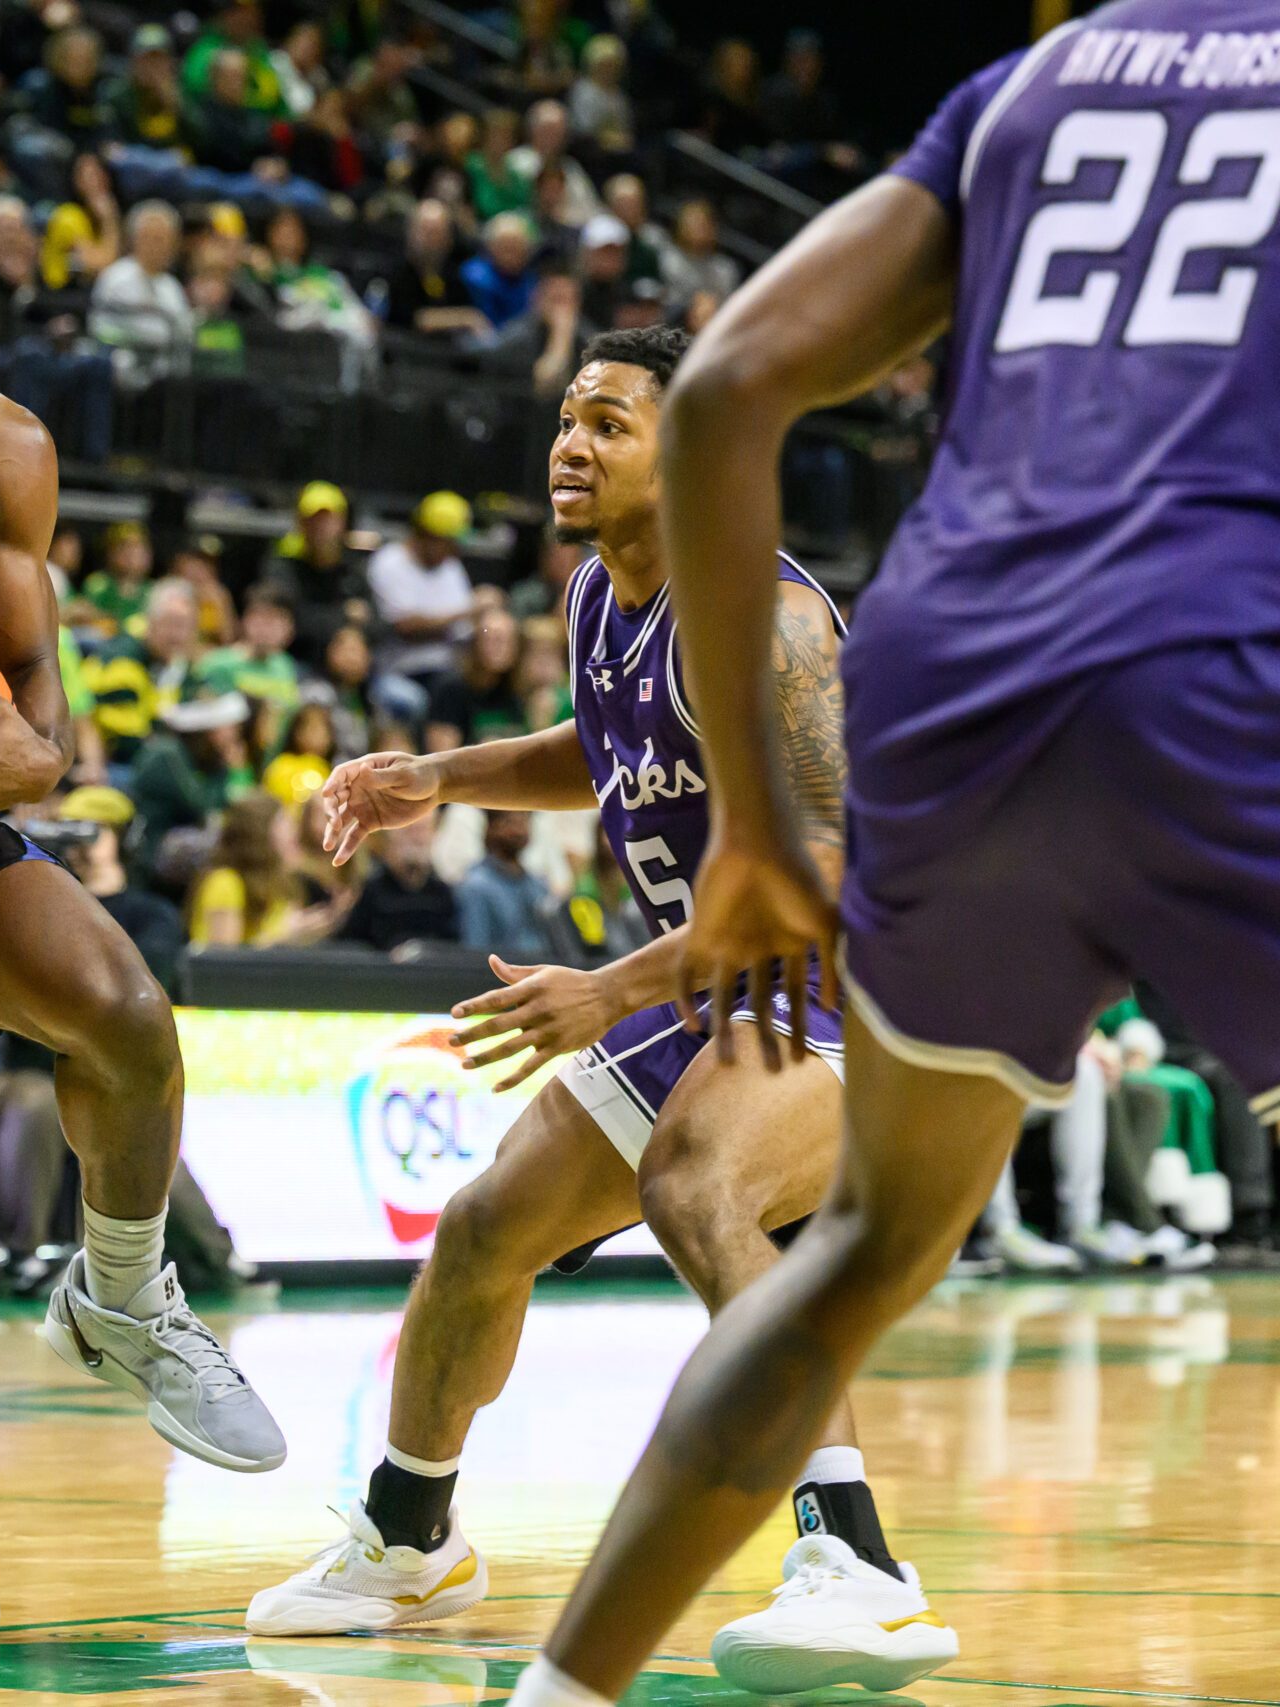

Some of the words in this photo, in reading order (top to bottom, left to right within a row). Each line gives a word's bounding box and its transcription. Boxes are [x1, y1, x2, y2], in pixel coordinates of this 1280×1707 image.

[993, 108, 1280, 353] 22
[624, 835, 695, 934] 5
[380, 1088, 473, 1179] QSL
